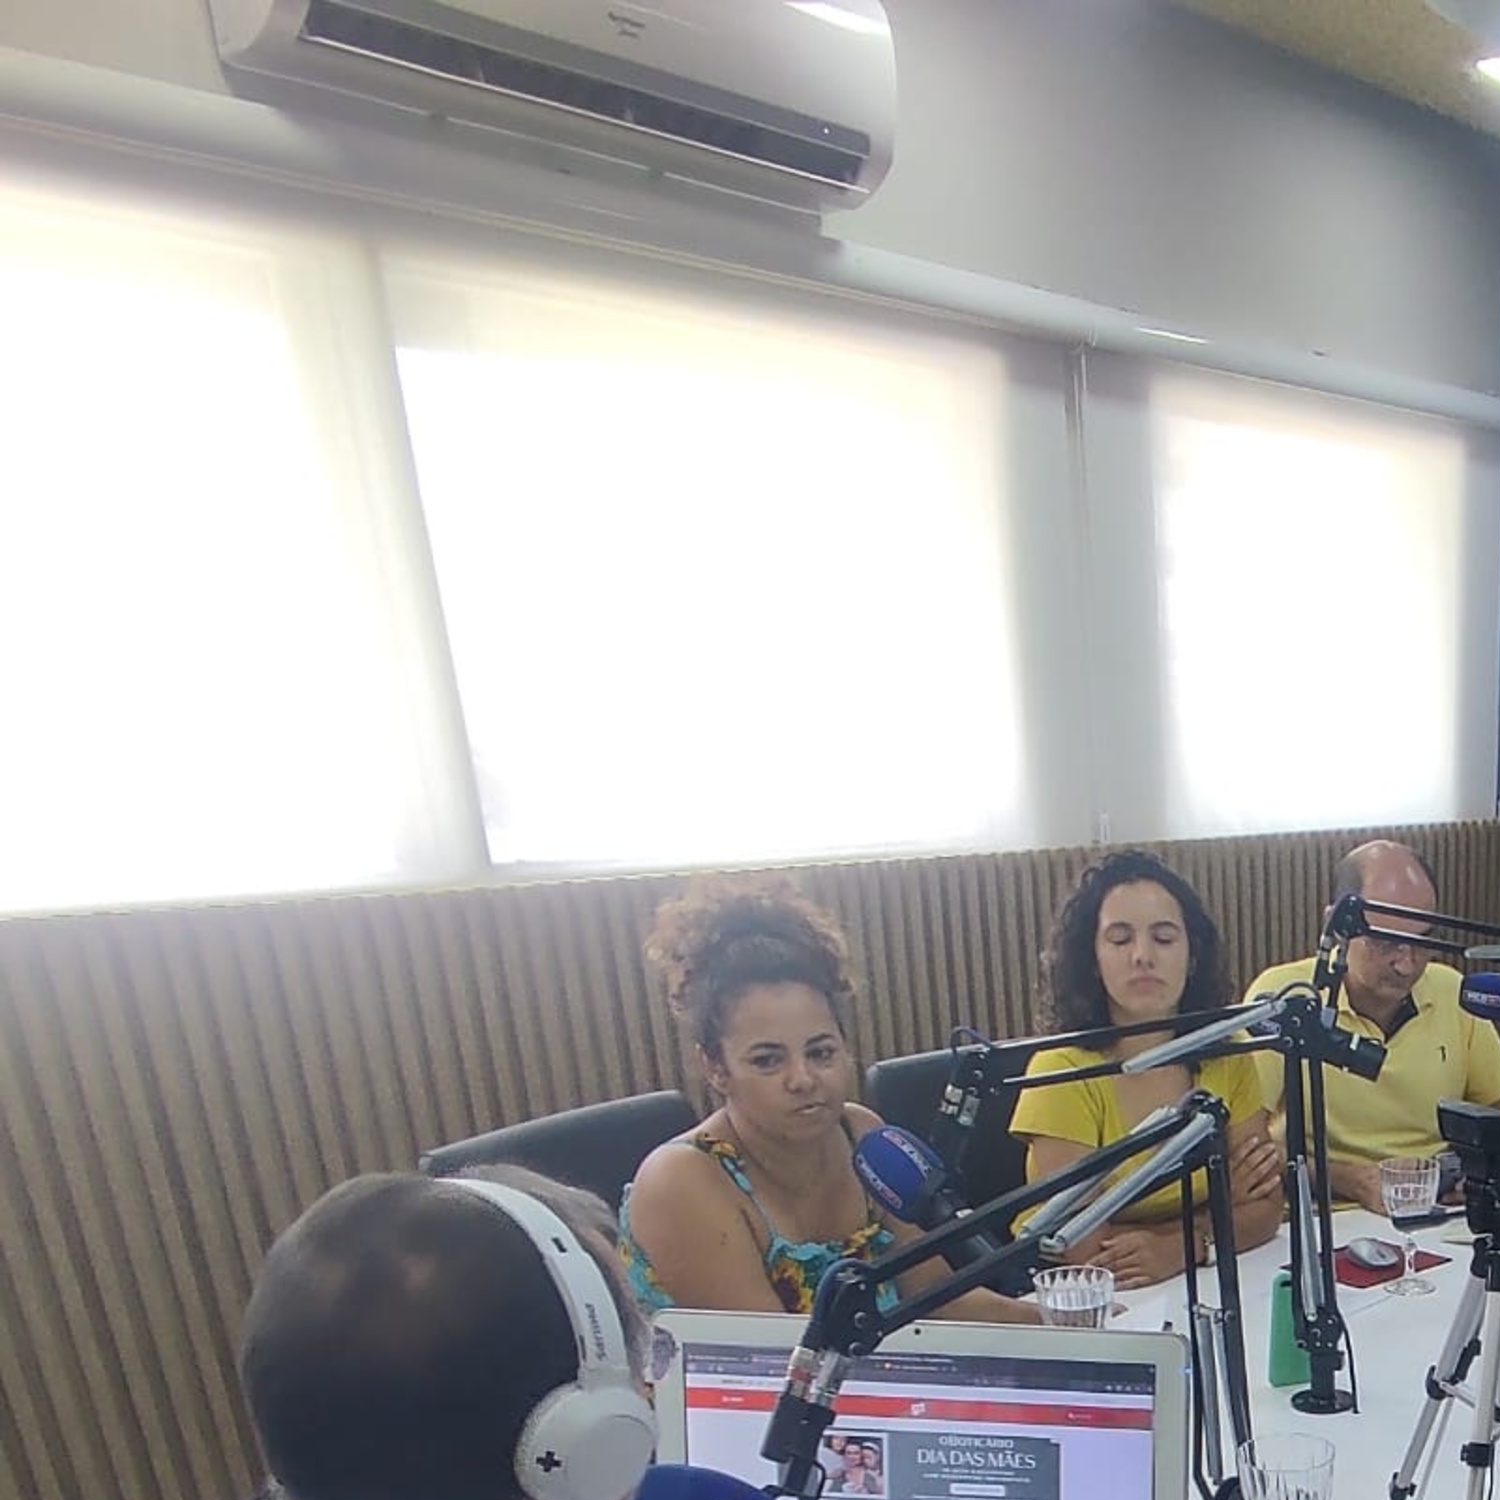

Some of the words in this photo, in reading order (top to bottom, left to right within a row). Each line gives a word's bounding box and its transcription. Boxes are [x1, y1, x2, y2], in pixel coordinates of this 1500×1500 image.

[917, 1448, 948, 1465] DIA
[949, 1450, 985, 1468] DAS
[987, 1450, 1036, 1469] MÃES
